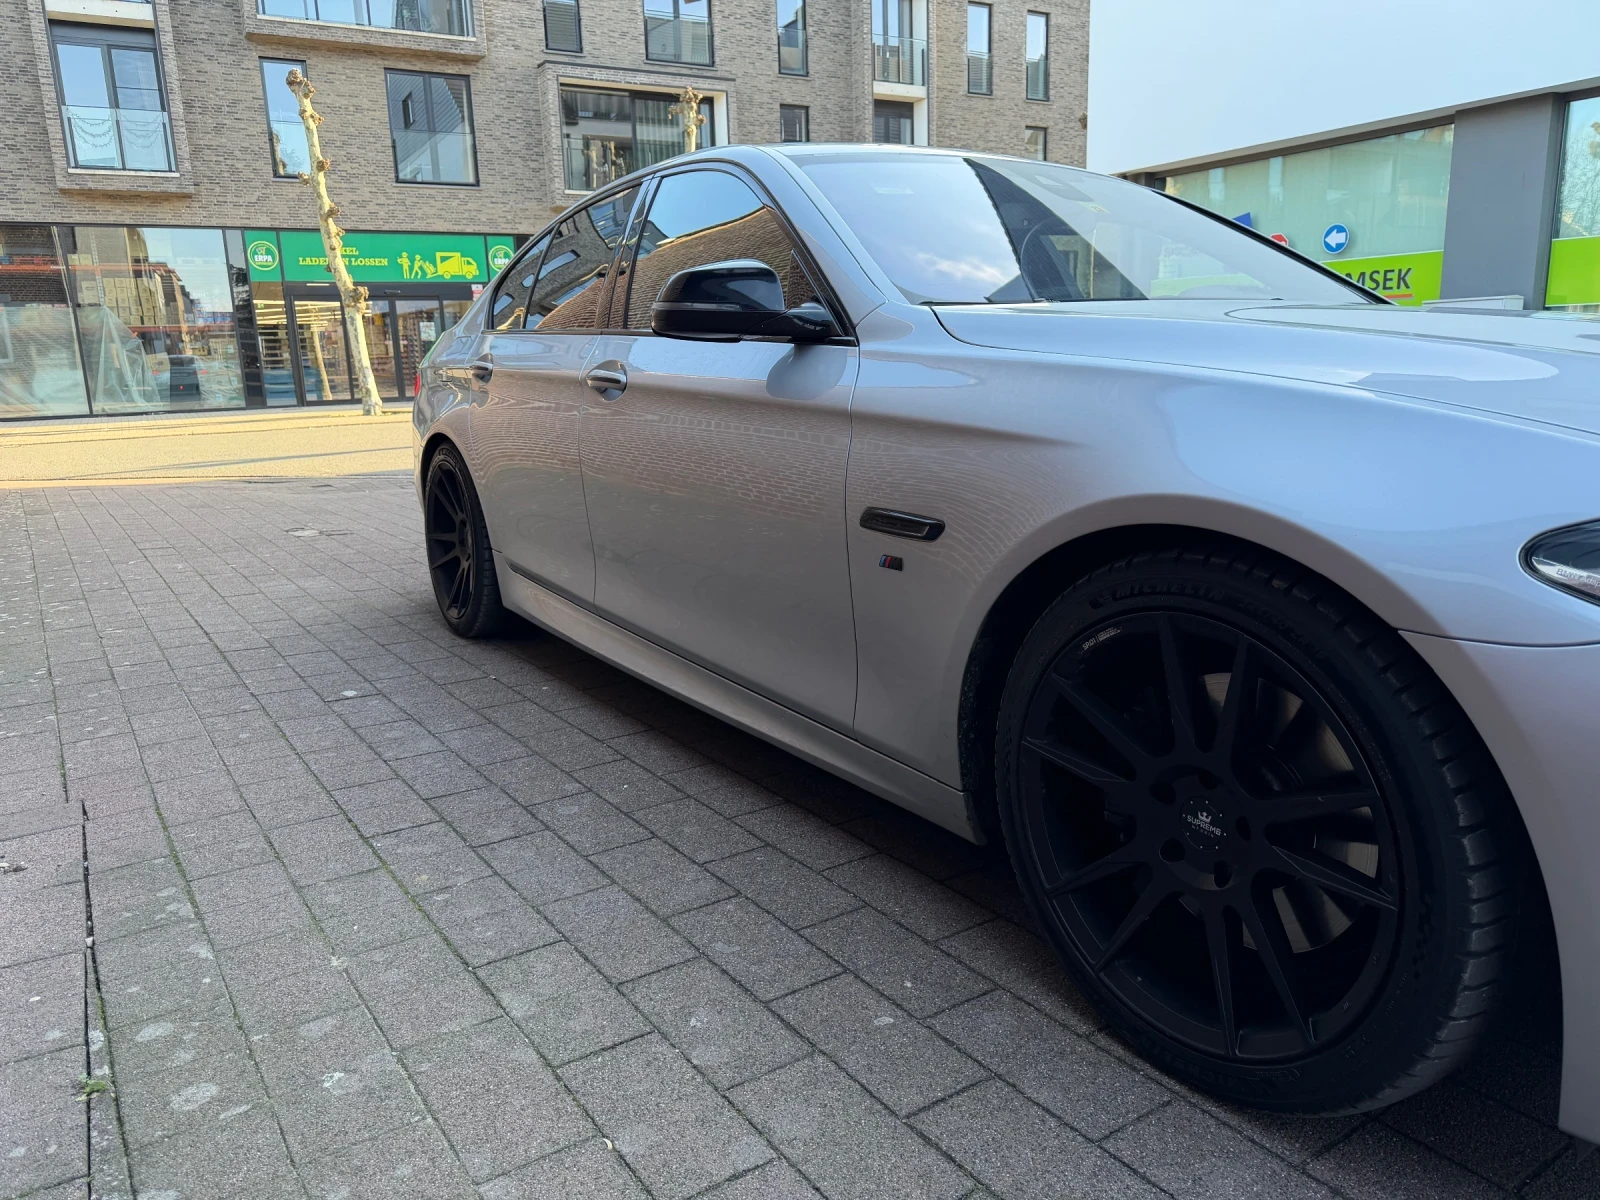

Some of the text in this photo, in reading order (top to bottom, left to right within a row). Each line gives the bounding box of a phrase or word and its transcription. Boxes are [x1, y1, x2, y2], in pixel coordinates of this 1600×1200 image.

[340, 247, 359, 255] KEL
[254, 254, 273, 262] ERPA
[351, 258, 388, 266] LOSSEN
[1556, 568, 1580, 579] BMW
